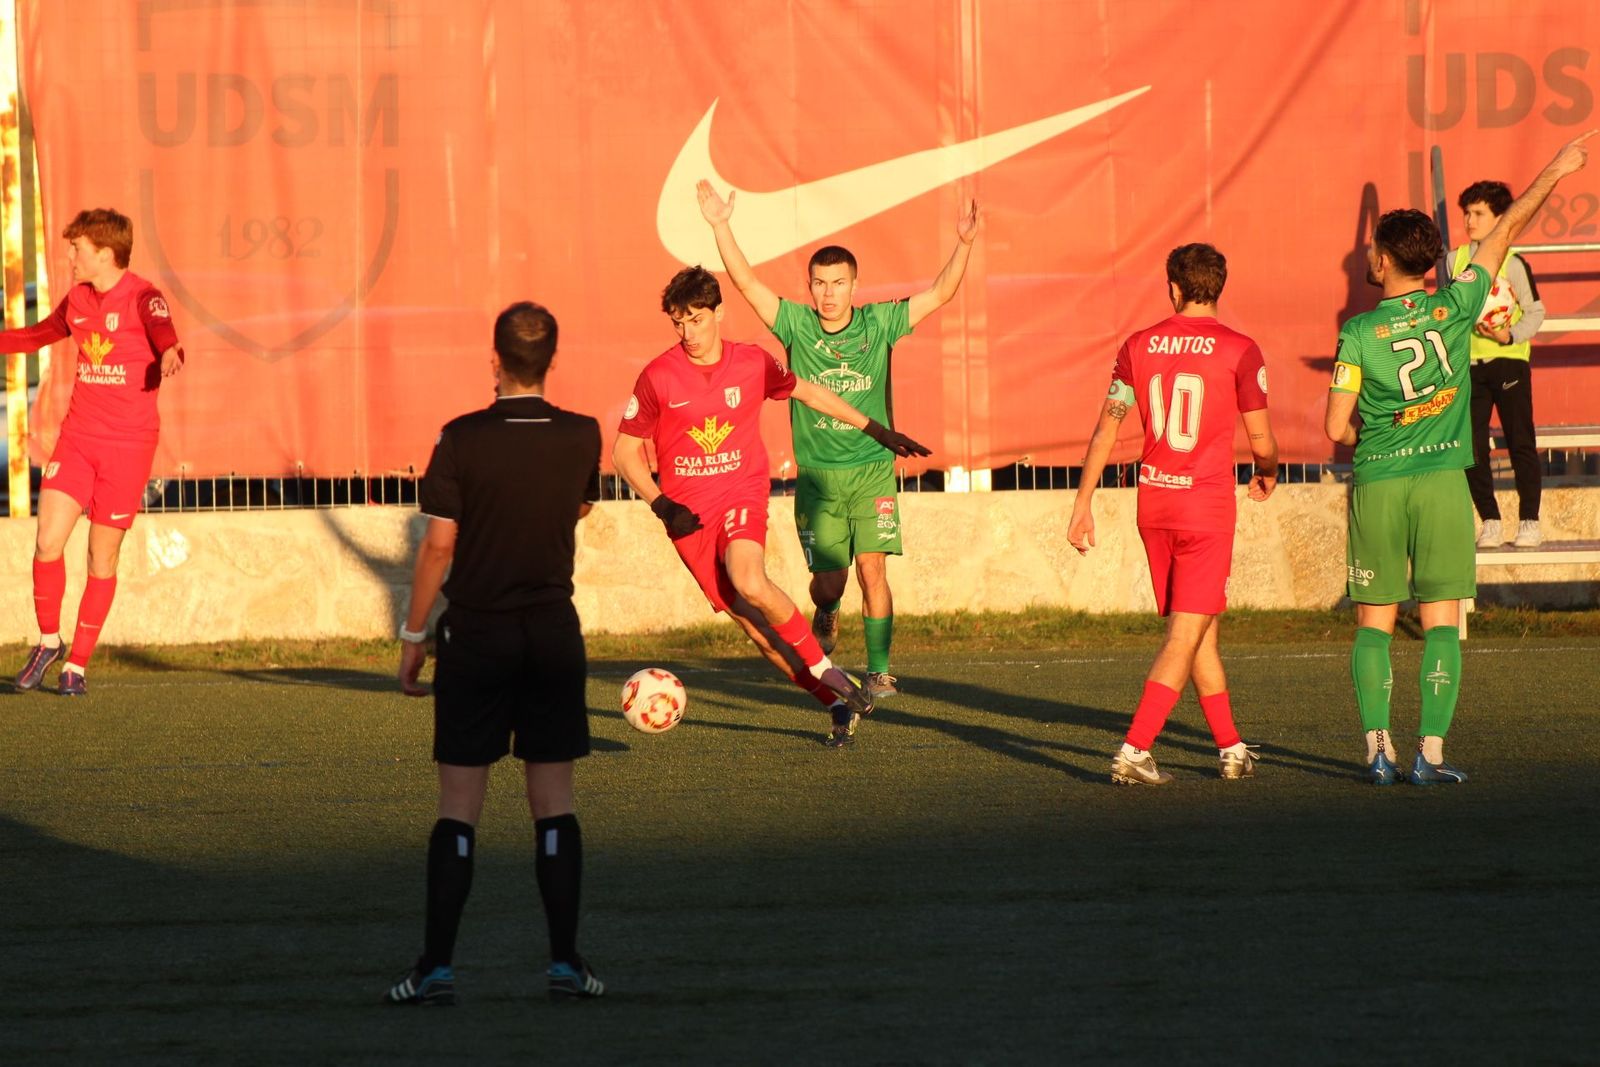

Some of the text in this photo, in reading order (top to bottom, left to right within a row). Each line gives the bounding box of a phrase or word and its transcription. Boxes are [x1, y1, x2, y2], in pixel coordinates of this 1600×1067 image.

[138, 72, 399, 148] UDSM
[216, 214, 325, 261] 1982
[1147, 335, 1216, 355] SANTOS
[1390, 329, 1454, 402] 21
[1149, 372, 1204, 453] 10
[674, 449, 742, 469] CAJA RURAL
[1150, 466, 1193, 486] Lincasa
[723, 507, 748, 531] 21
